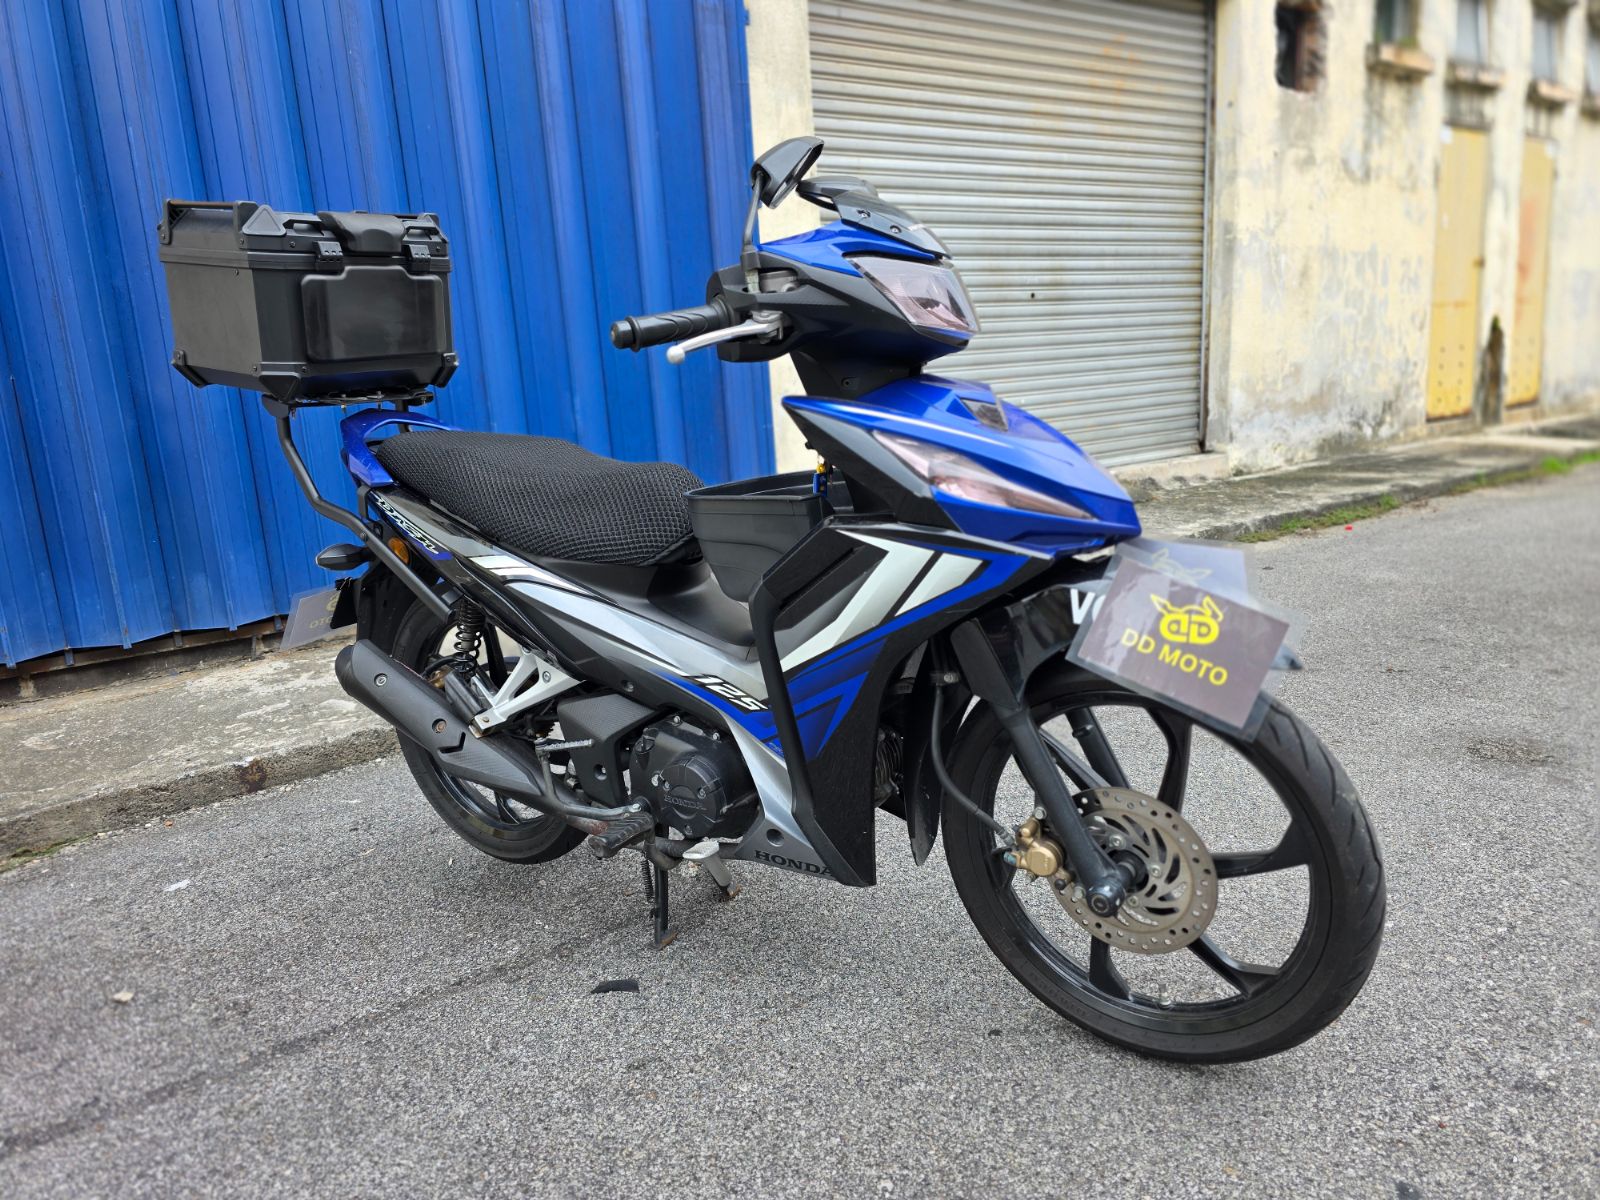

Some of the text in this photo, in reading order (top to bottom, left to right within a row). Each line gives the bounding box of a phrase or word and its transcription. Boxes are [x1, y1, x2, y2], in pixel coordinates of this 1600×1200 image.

[1121, 627, 1228, 686] DD MOTO
[694, 674, 769, 711] 125
[754, 849, 833, 876] HONDA
